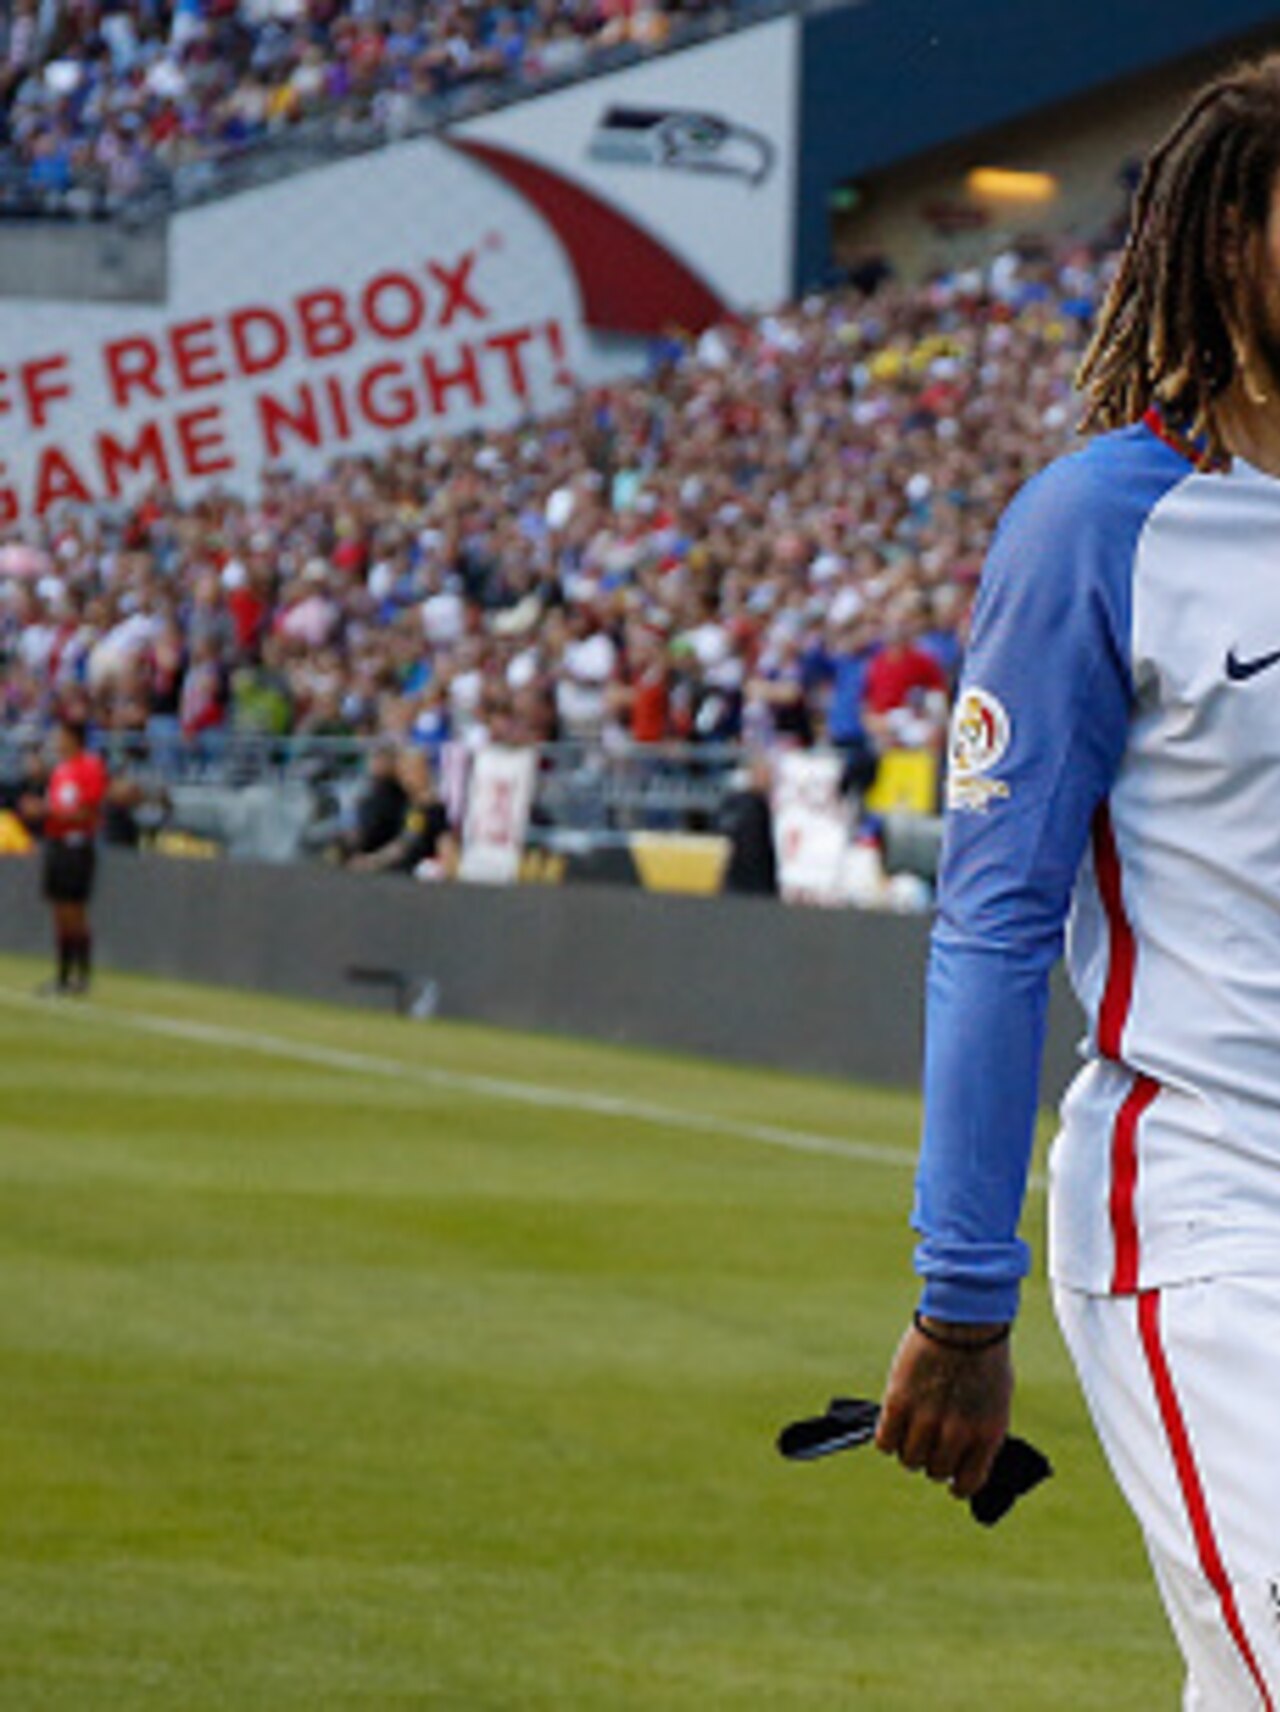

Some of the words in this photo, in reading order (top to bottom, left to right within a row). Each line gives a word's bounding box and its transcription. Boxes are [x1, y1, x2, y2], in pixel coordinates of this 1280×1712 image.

[0, 355, 70, 429] F
[104, 253, 487, 407] REDBOX
[257, 319, 573, 458] NIGHT!
